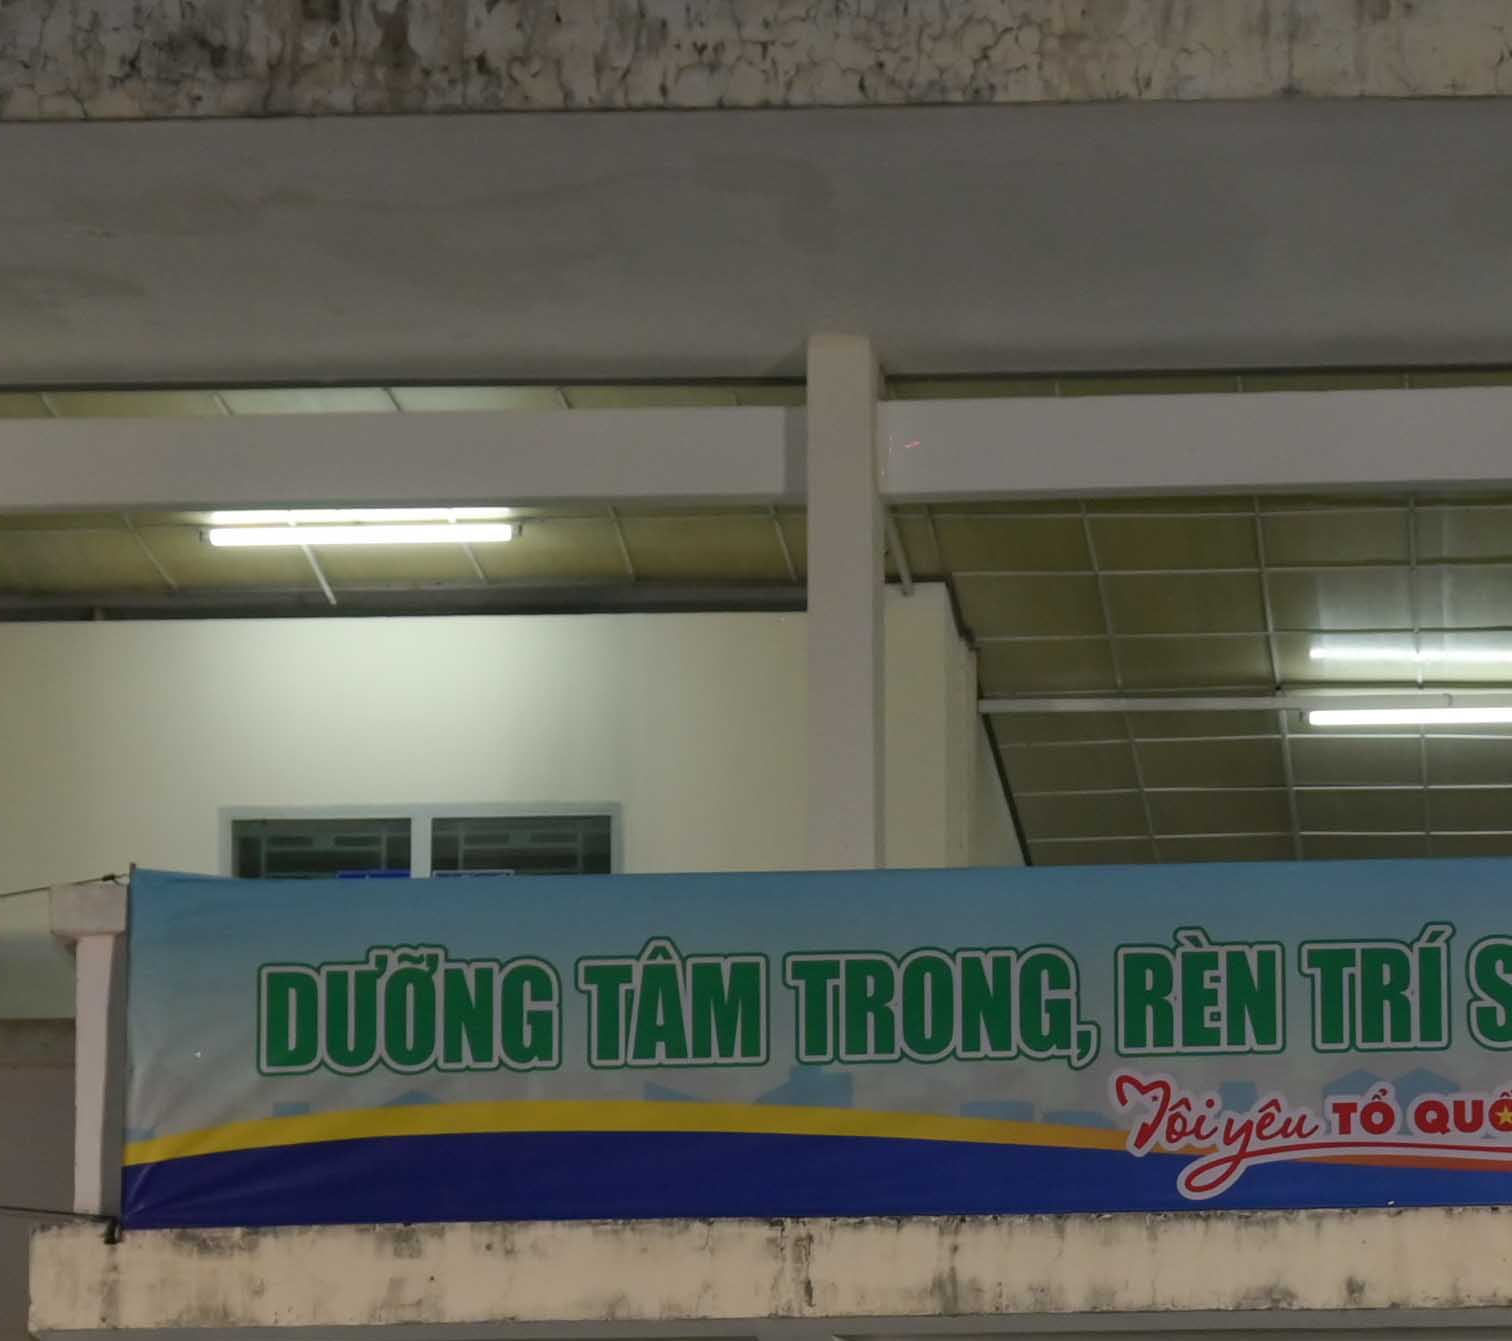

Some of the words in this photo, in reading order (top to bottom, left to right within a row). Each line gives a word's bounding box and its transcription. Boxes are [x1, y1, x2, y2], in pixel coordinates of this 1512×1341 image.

[260, 946, 560, 1072] DƯỠNG
[580, 939, 766, 1066] TÂM
[786, 946, 1098, 1067] TRONG,
[1118, 929, 1282, 1056] RÈN
[1306, 924, 1448, 1052] TRÍ
[1332, 1087, 1396, 1136] TỔ
